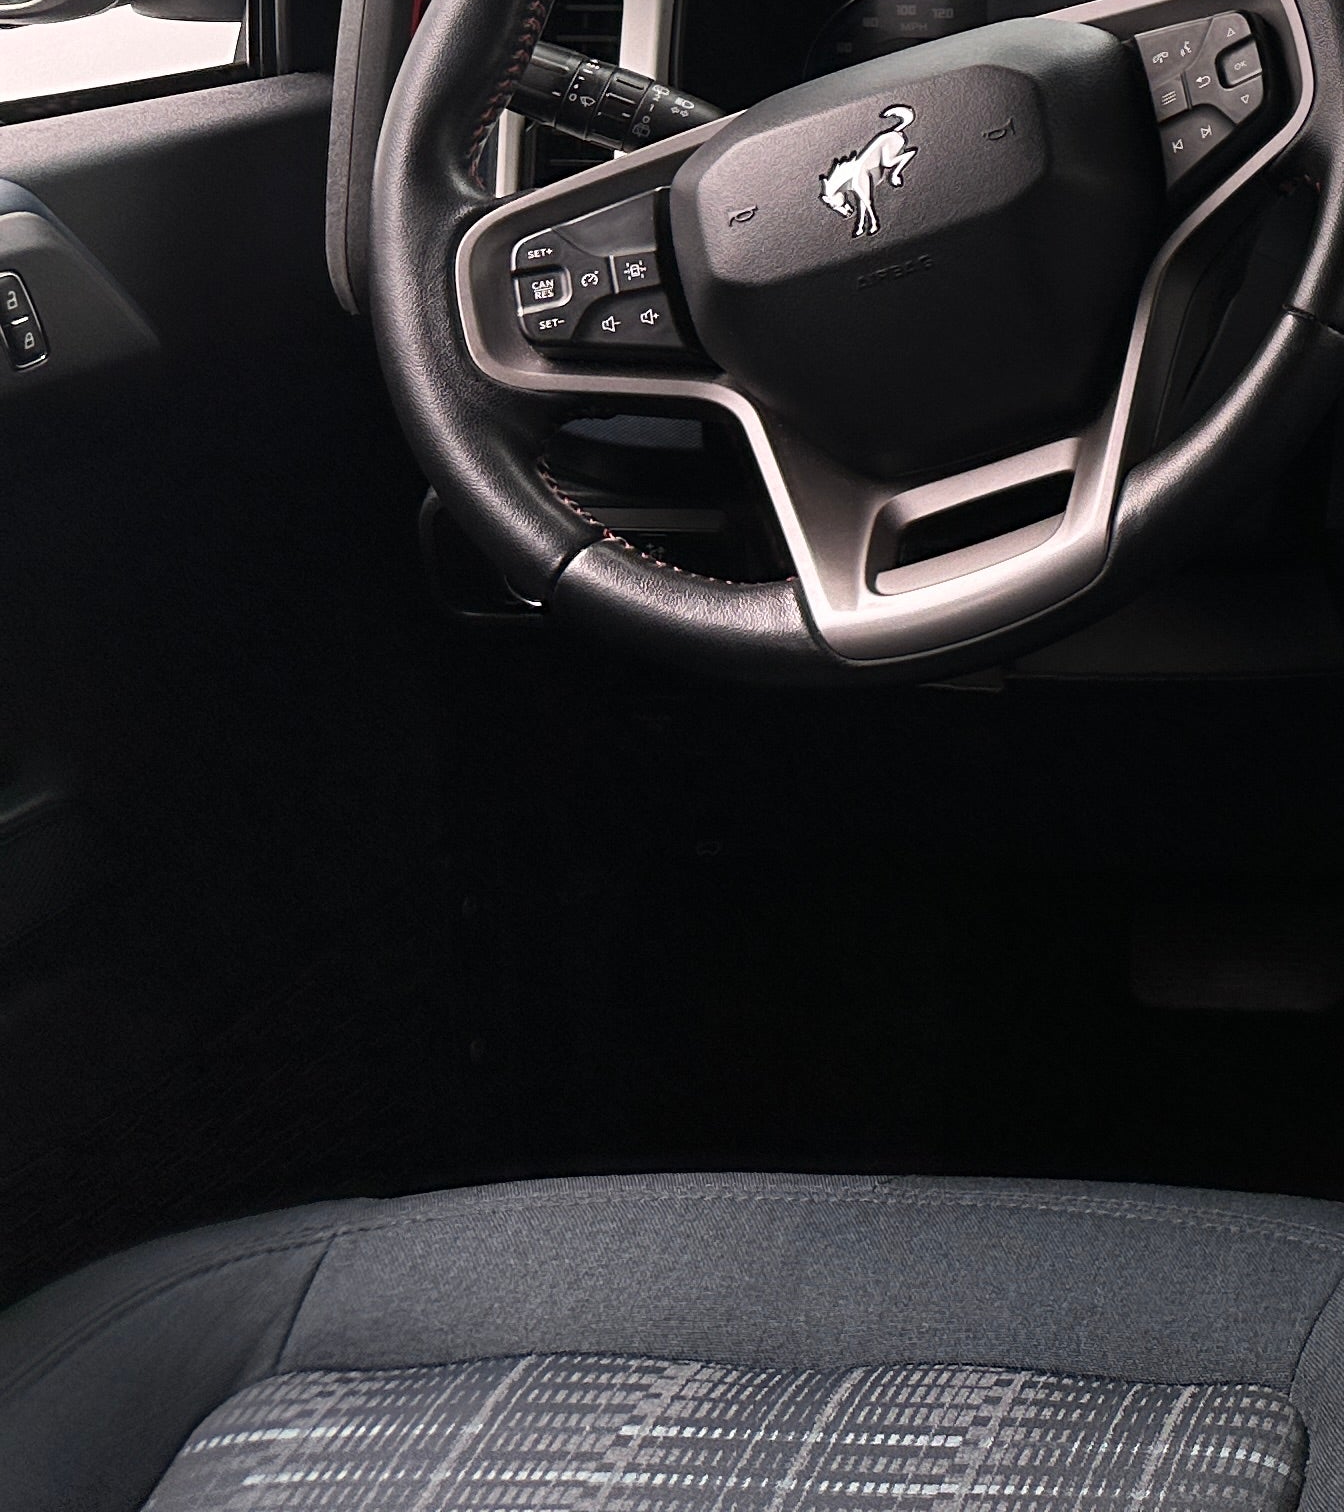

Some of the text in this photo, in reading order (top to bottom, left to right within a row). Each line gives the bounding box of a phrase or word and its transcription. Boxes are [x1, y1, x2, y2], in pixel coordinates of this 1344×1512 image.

[899, 23, 928, 32] MPH
[1234, 60, 1247, 70] OK
[531, 279, 554, 290] CAN
[534, 290, 555, 300] RES
